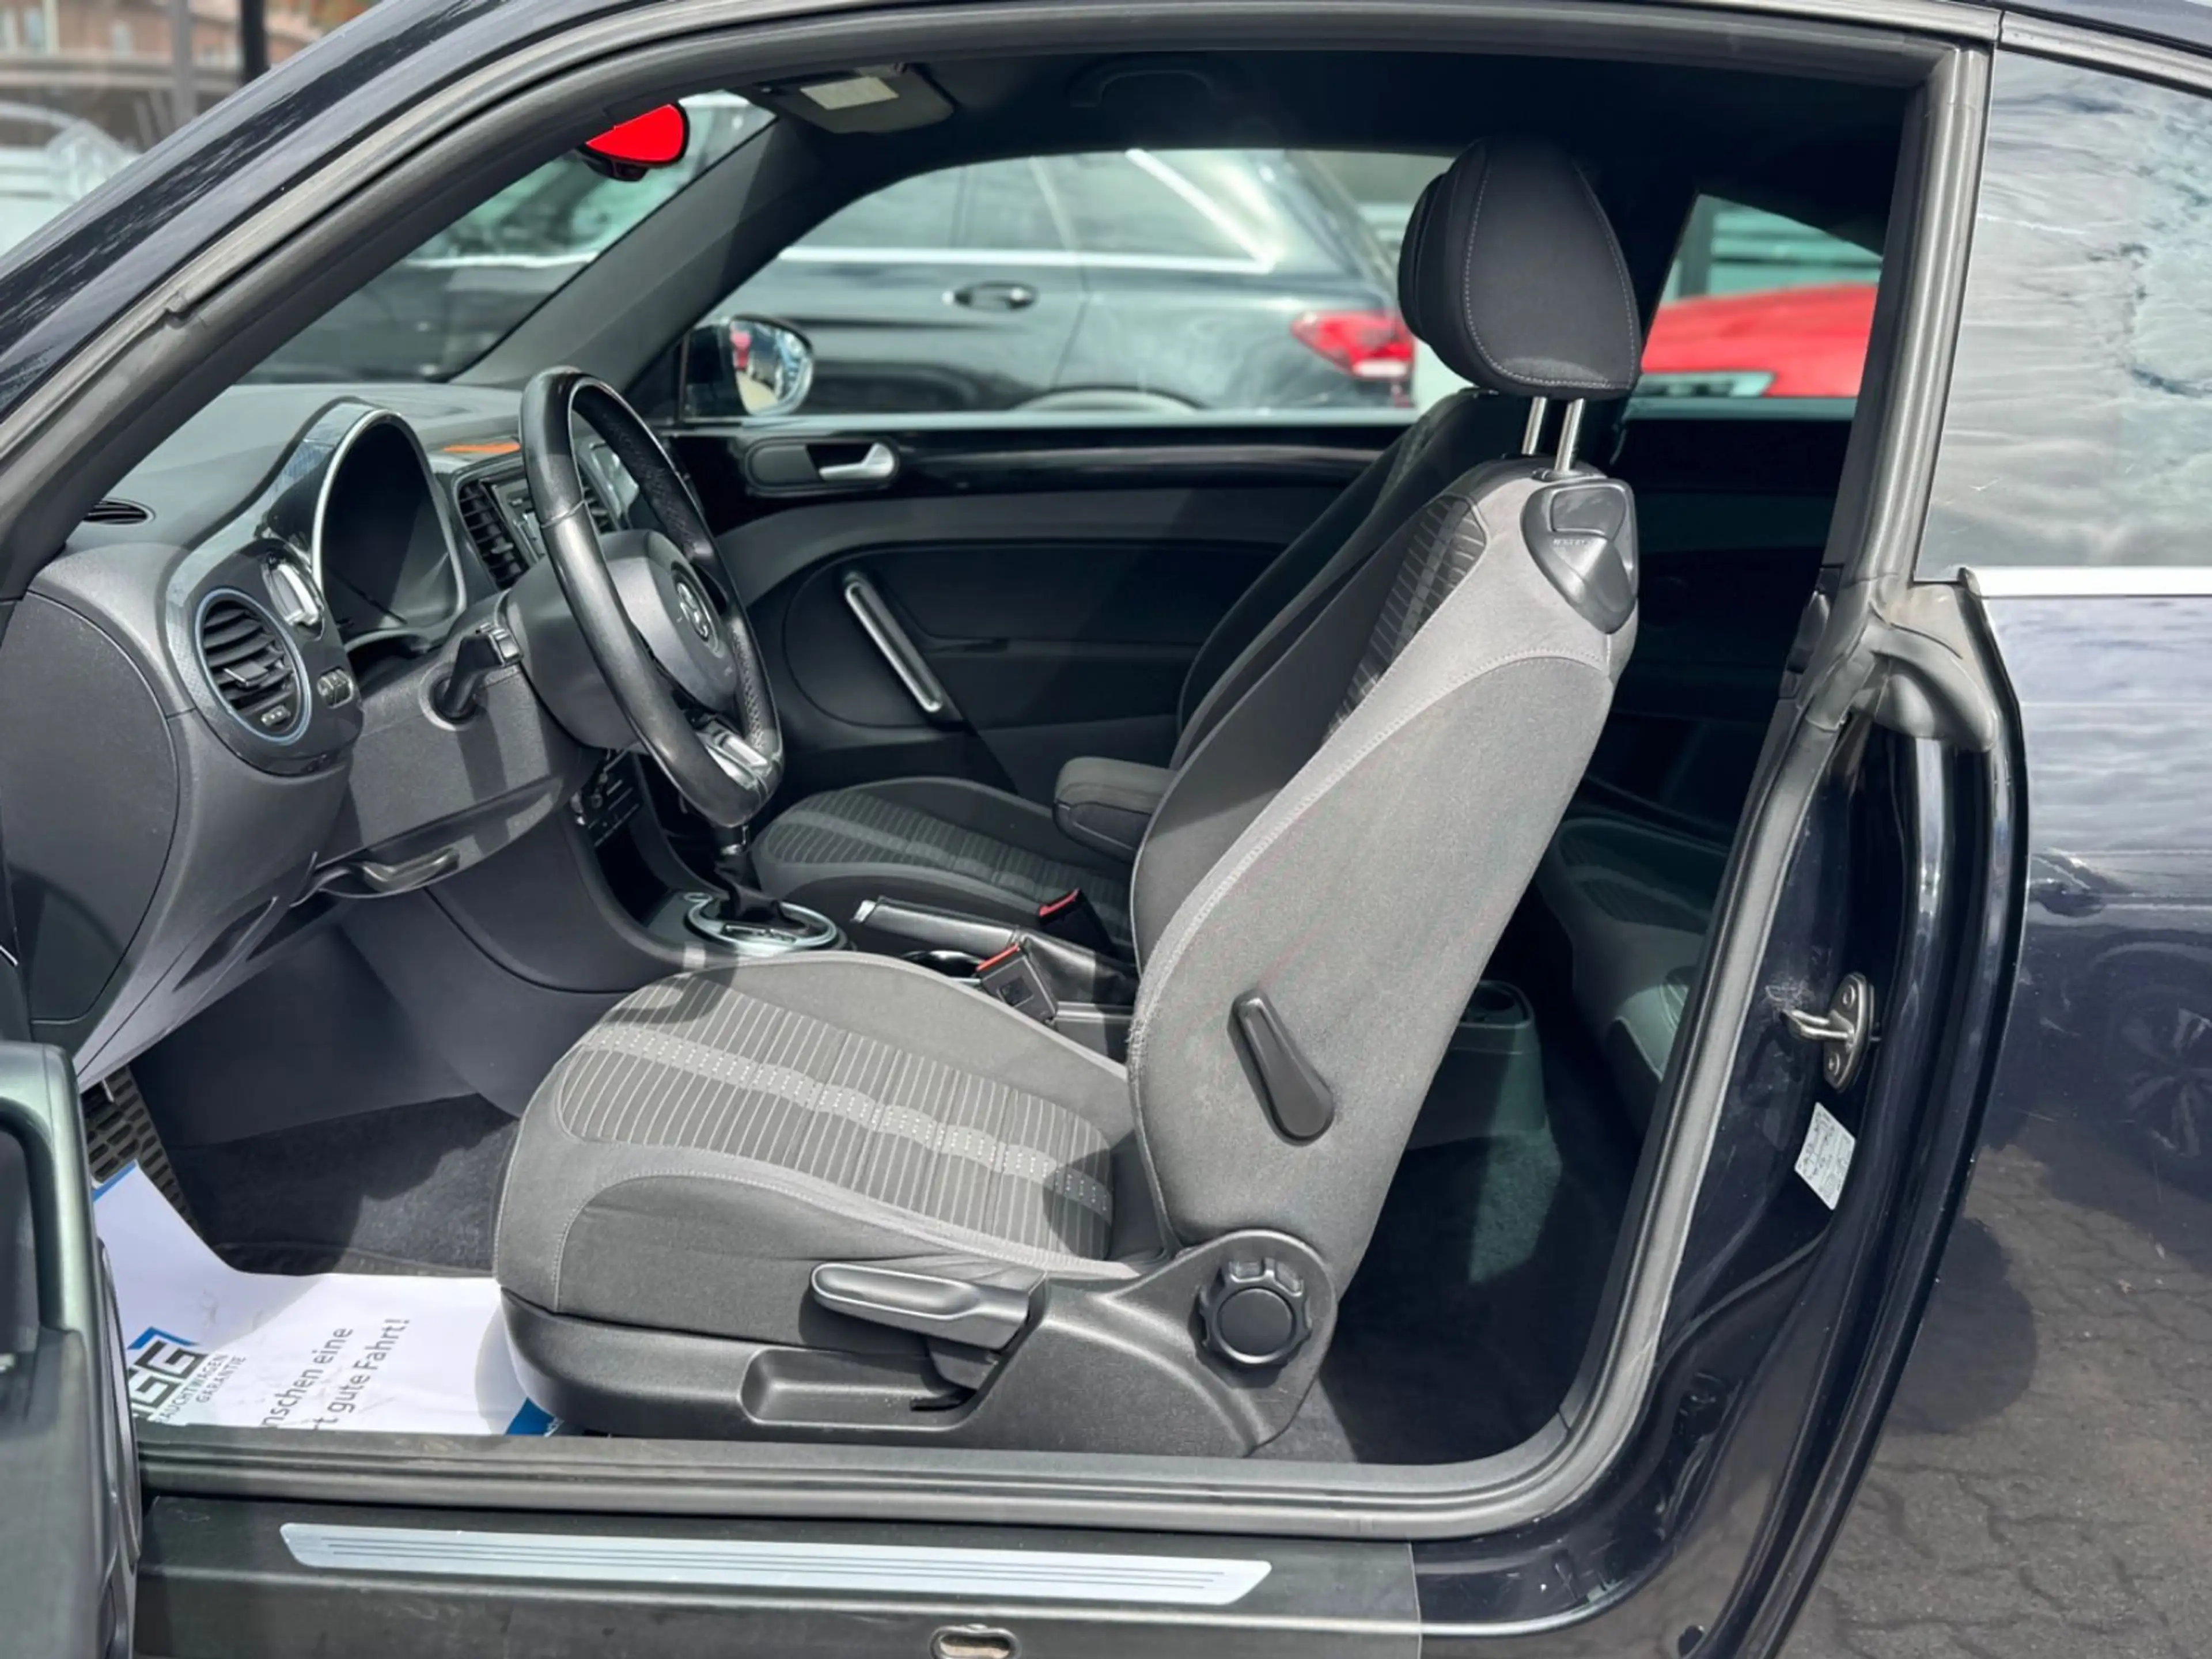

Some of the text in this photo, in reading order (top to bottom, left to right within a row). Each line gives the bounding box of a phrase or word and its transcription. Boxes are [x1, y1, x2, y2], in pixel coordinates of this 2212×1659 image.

[312, 1328, 353, 1364] eine
[327, 1374, 370, 1412] gute
[353, 1319, 410, 1370] Fahrt!
[127, 1340, 209, 1418] GG
[196, 1356, 246, 1402] GARANTIE
